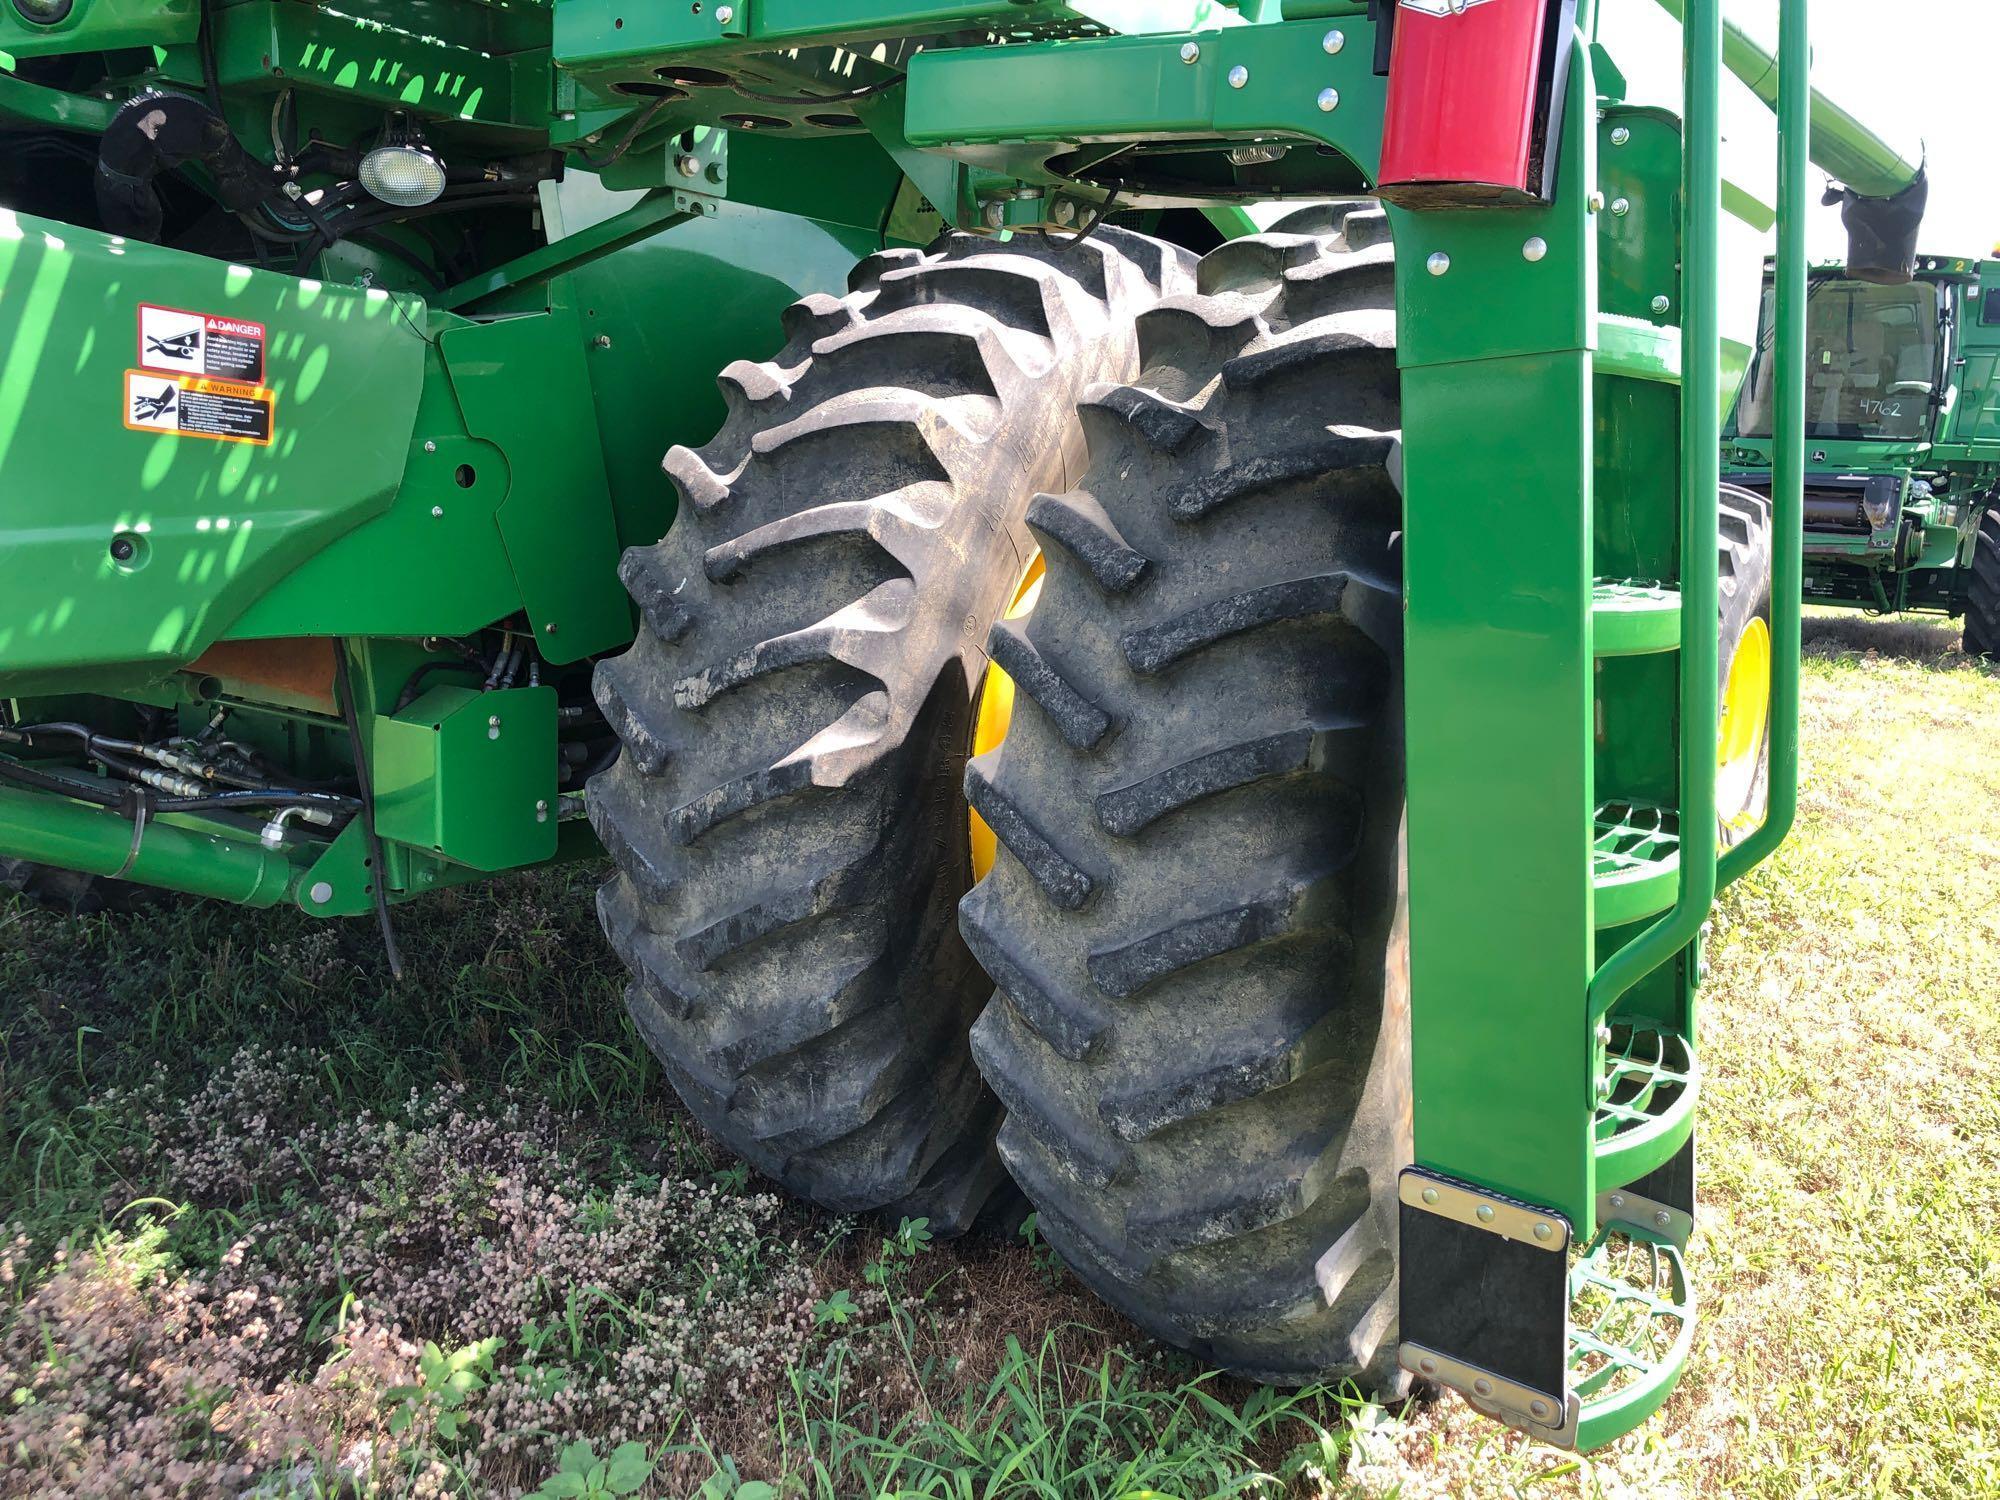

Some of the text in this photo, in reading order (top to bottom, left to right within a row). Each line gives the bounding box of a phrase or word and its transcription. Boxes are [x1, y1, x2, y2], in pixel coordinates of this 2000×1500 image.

[1955, 260, 1965, 272] 2
[217, 320, 261, 336] DANGER
[211, 384, 256, 397] WARNING
[1859, 398, 1902, 417] 4762
